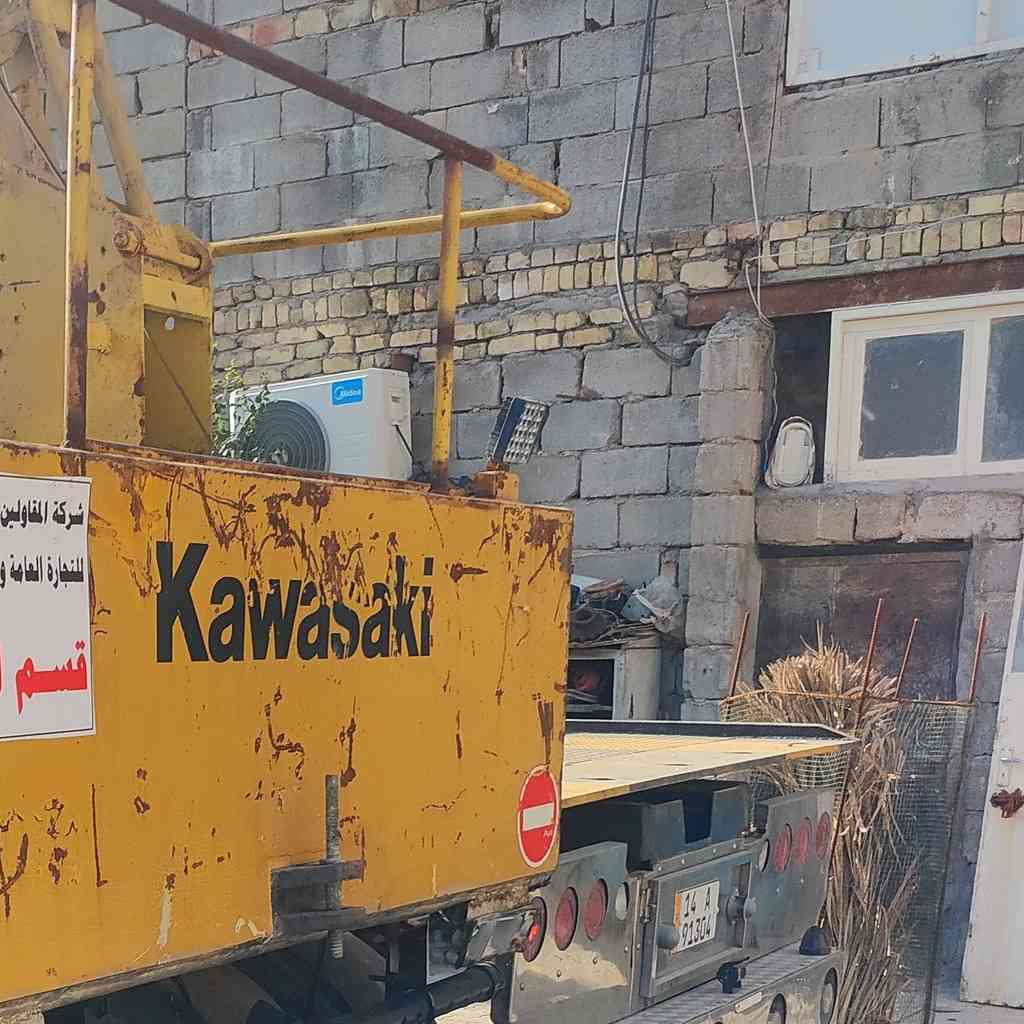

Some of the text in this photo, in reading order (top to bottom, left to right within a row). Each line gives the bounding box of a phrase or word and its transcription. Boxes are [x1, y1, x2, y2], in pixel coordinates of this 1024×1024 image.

[0, 498, 48, 529] المقاولين
[52, 499, 85, 530] شركة
[9, 553, 43, 584] العامة
[47, 555, 84, 589] للتجارة
[156, 540, 434, 663] Kawasaki
[15, 639, 88, 715] قسم
[684, 890, 696, 918] 14
[704, 887, 712, 911] A
[682, 914, 712, 947] 91304
